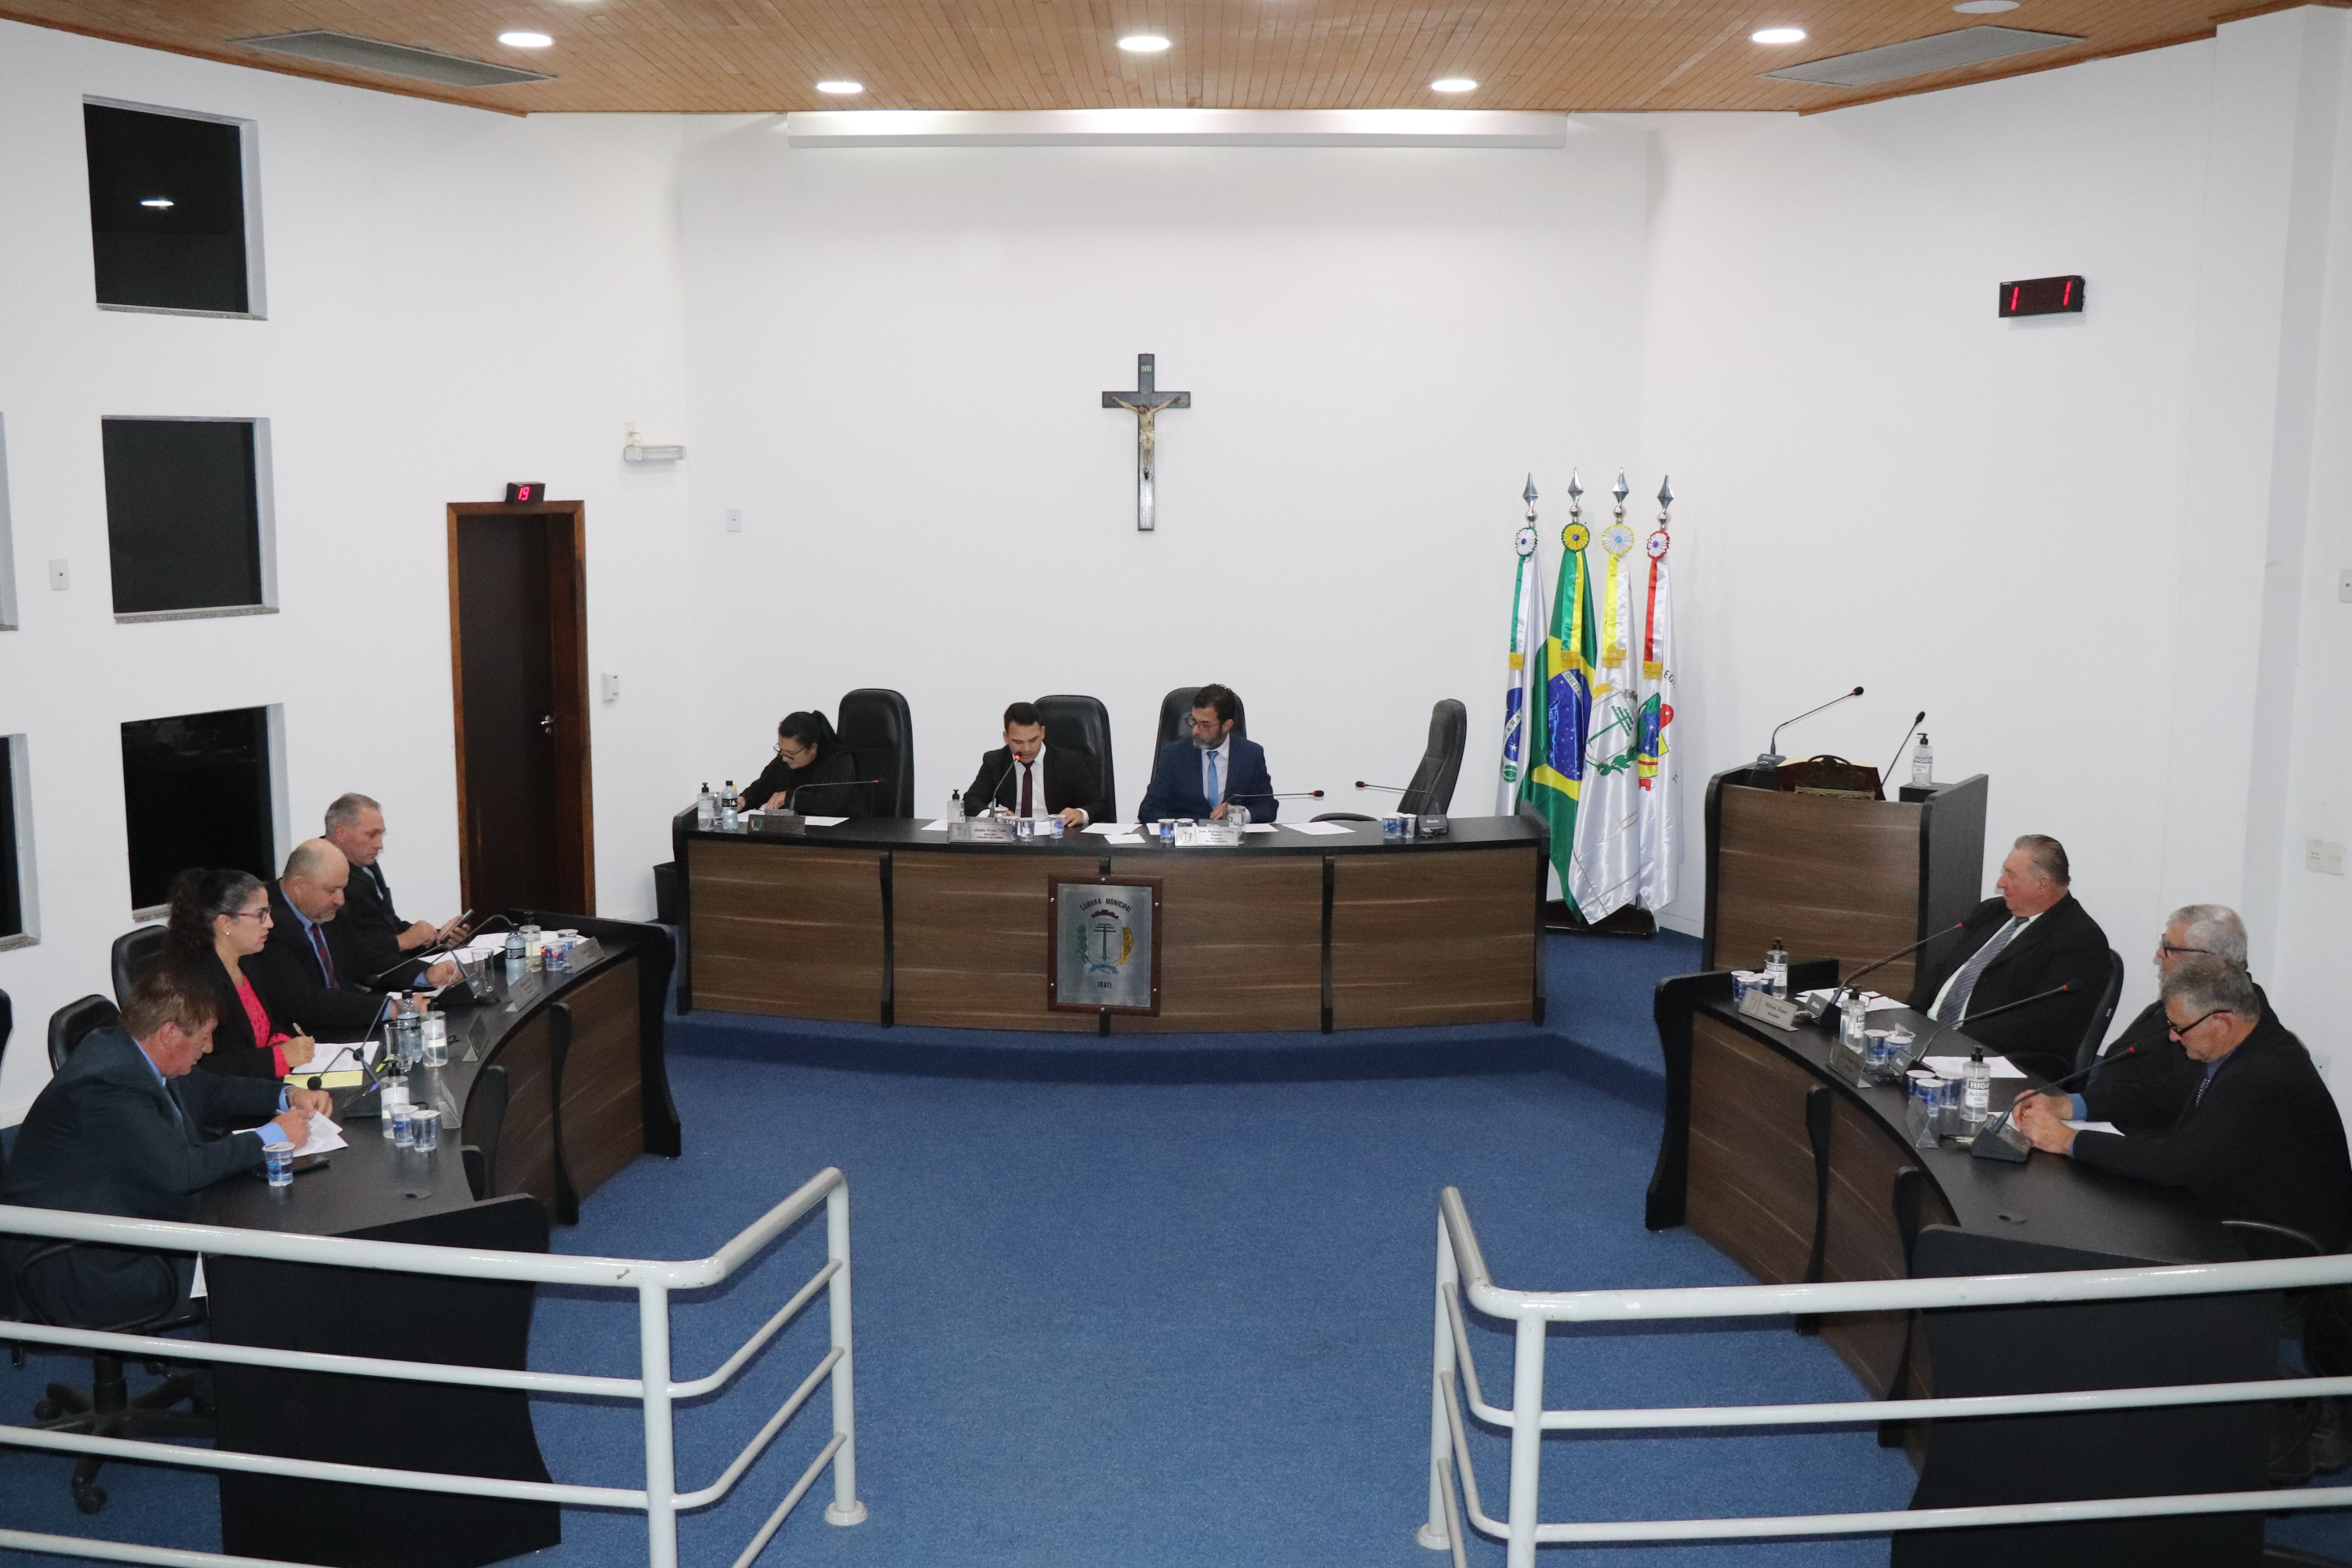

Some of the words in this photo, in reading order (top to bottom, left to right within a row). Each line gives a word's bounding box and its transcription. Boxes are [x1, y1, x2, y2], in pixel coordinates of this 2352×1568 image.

[518, 486, 532, 501] 19
[1566, 673, 1581, 695] ORDE
[1105, 898, 1133, 913] MUNICIPAL
